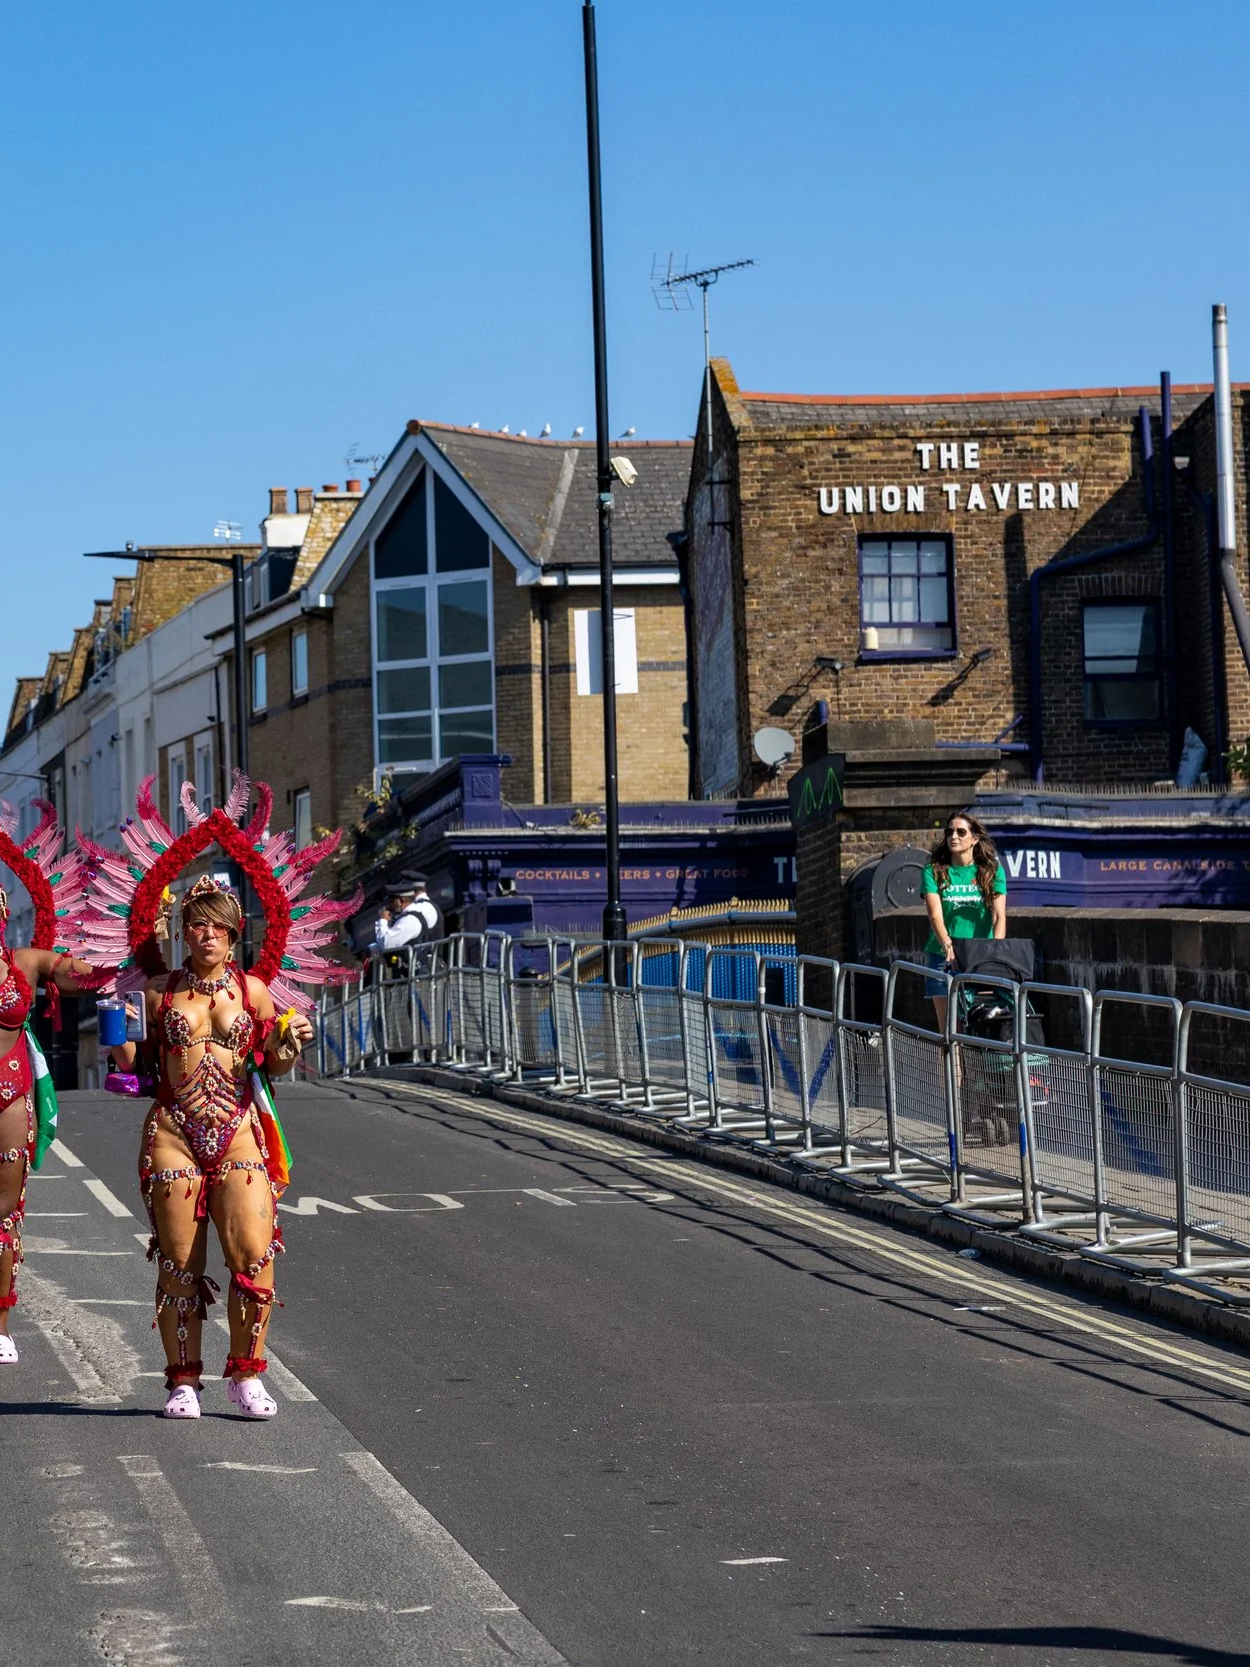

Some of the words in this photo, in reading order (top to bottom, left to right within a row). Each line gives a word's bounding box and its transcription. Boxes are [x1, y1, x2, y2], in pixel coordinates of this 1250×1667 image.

[916, 442, 980, 470] THE
[818, 484, 925, 514] UNION
[942, 481, 1080, 511] TAVERN
[516, 870, 590, 880] COCKTAILS
[618, 869, 650, 880] EERS
[665, 869, 709, 880] GREAT
[713, 868, 748, 879] FOOD
[996, 849, 1061, 879] VERN
[1100, 860, 1147, 871] LARGE
